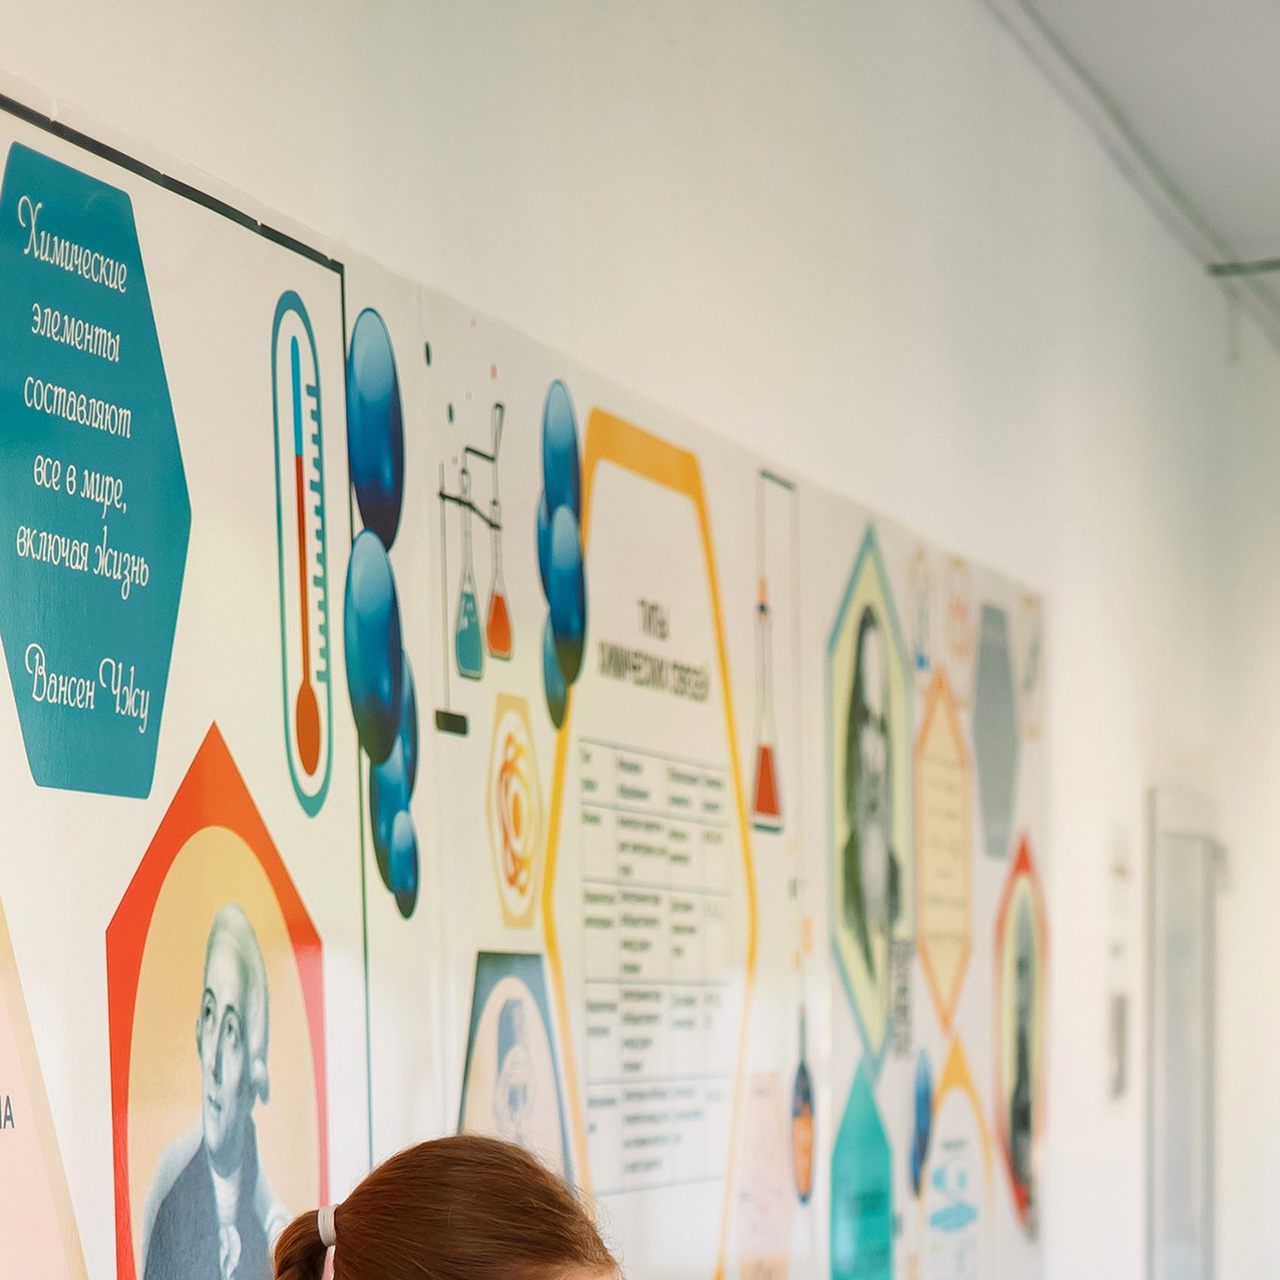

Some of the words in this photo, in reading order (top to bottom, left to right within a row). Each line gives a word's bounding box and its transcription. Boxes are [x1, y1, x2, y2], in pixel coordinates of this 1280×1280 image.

[18, 195, 127, 293] Химические
[31, 302, 120, 363] элементы
[24, 376, 132, 439] составляют
[34, 455, 61, 491] все
[66, 464, 77, 495] в
[80, 468, 127, 519] мире,
[16, 525, 89, 571] включая
[93, 525, 150, 600] жизнь
[25, 643, 95, 710] Вансен
[99, 657, 150, 734] Чжу
